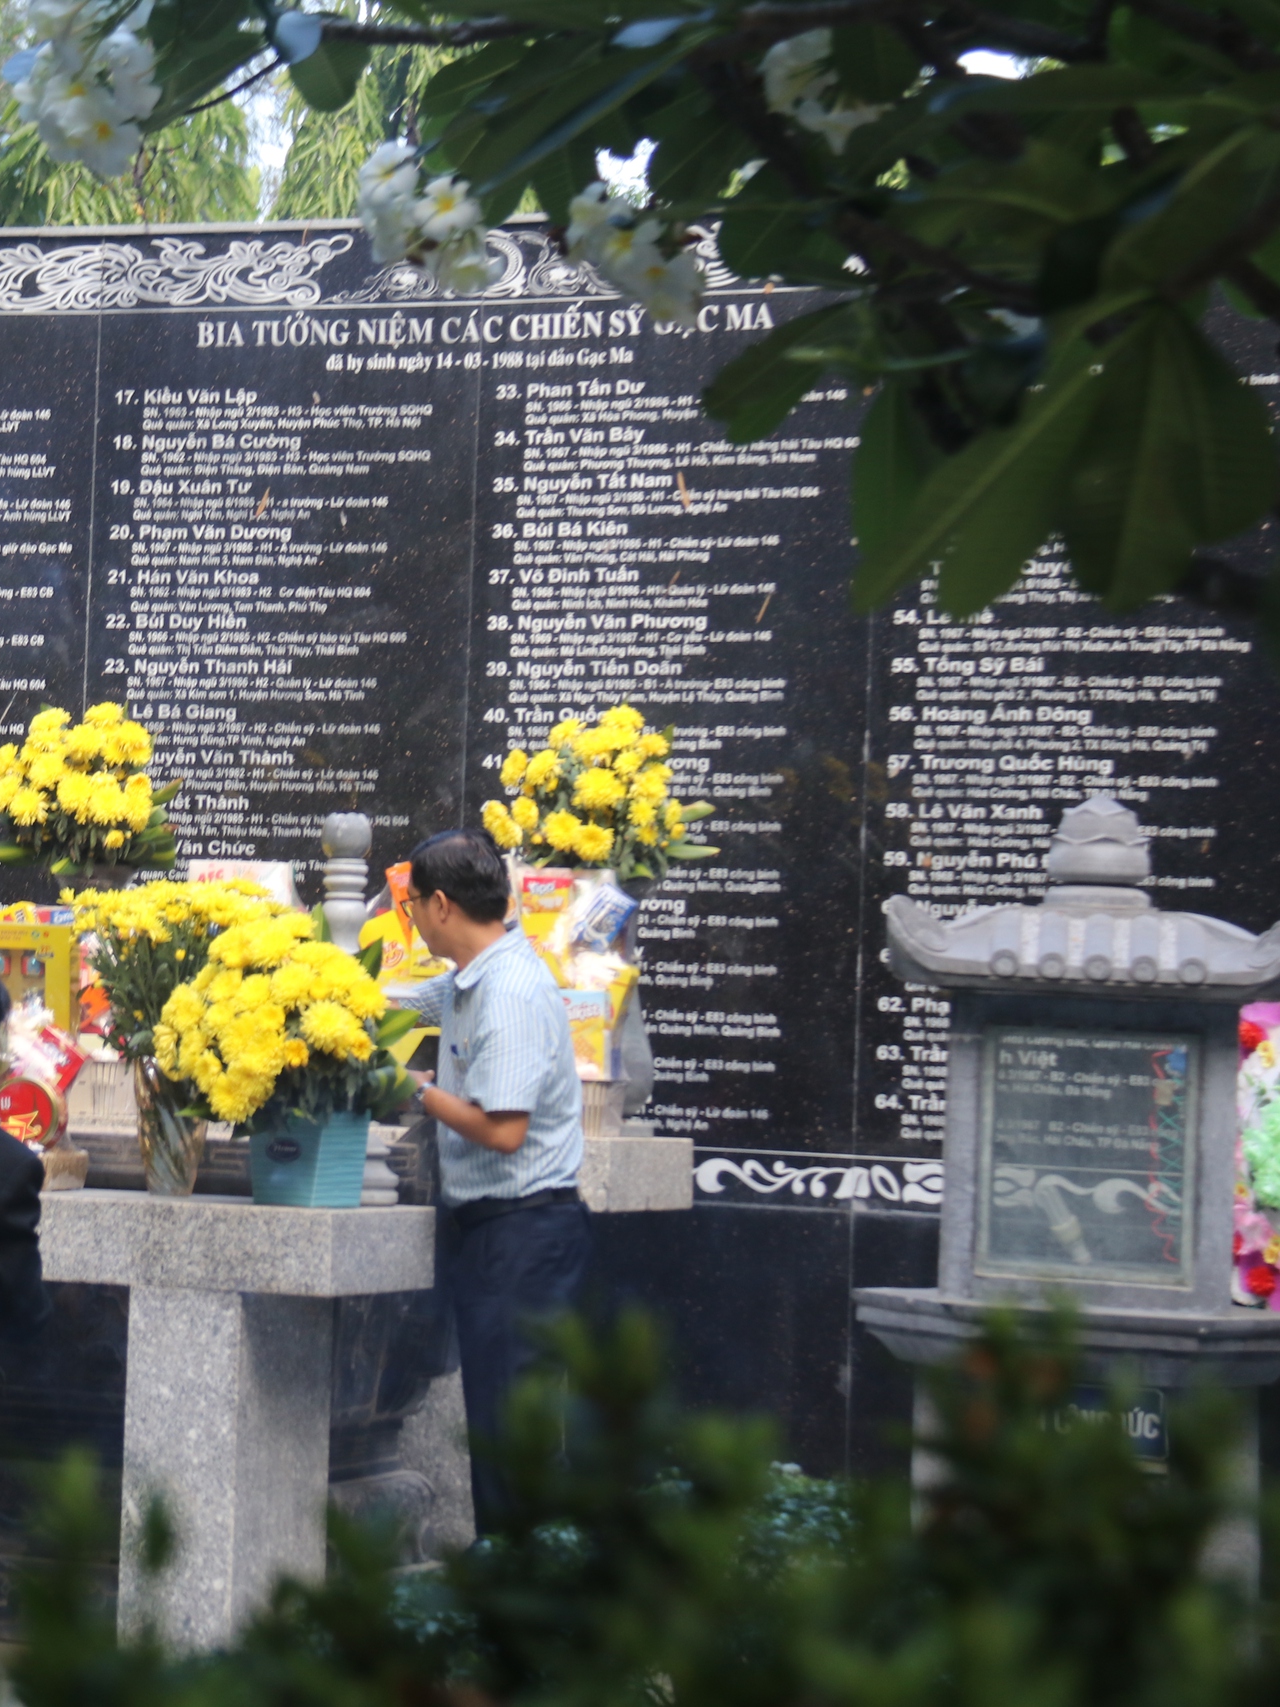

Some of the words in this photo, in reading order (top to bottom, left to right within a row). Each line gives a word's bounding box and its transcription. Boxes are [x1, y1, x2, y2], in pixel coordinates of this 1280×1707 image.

[197, 320, 244, 348] BIA
[252, 310, 351, 347] TƯỞNG
[357, 311, 434, 350] NIỆM
[441, 309, 503, 345] CÁC
[510, 300, 604, 342] CHIẾN
[608, 303, 646, 338] SỸ
[725, 303, 774, 331] MA
[326, 353, 344, 371] đã
[347, 353, 364, 374] hy
[366, 353, 396, 370] sinh
[398, 352, 433, 373] ngày
[492, 351, 524, 369] 1988
[525, 350, 546, 370] tại
[576, 348, 607, 368] Gạc
[609, 346, 634, 365] Ma
[115, 390, 138, 405] 17.
[144, 386, 183, 404] Kiều
[187, 389, 220, 404] Văn
[225, 388, 257, 406] Lập
[496, 384, 522, 400] 33.
[527, 382, 572, 398] Phan
[577, 378, 611, 396] Tấn
[113, 435, 137, 450] 18.
[142, 432, 207, 453] Nguyễn
[212, 434, 235, 450] Bá
[240, 434, 301, 452] Cường
[494, 431, 521, 446] 34.
[524, 426, 565, 445] Trần
[569, 427, 604, 443] Văn
[111, 479, 135, 495] 19.
[139, 479, 173, 498] Đậu
[177, 479, 222, 495] Xuân
[492, 476, 519, 493] 35.
[524, 472, 592, 494] Nguyễn
[597, 470, 627, 489] Tất
[631, 472, 673, 488] Nam
[110, 524, 134, 540] 20.
[139, 524, 188, 543] Phạm
[192, 524, 226, 540] Văn
[230, 524, 292, 543] Dương
[492, 523, 518, 539] 36.
[557, 521, 582, 537] Bá
[586, 520, 628, 536] Kiên
[107, 569, 132, 585] 21.
[137, 569, 172, 585] Hán
[175, 569, 209, 585] Văn
[213, 569, 259, 585] Khoa
[488, 569, 515, 584] 37.
[519, 568, 544, 583] Võ
[594, 564, 639, 583] Tuấn
[106, 613, 131, 629] 22.
[169, 613, 204, 632] Duy
[487, 615, 514, 631] 38.
[518, 612, 587, 634] Nguyễn
[591, 614, 626, 630] Văn
[631, 613, 708, 631] Phương
[104, 658, 129, 674] 23.
[134, 656, 199, 676] Nguyễn
[205, 658, 258, 674] Thanh
[486, 661, 512, 676] 39.
[517, 659, 585, 679] Nguyễn
[589, 657, 630, 676] Tiến
[132, 704, 153, 719] Lê
[158, 704, 181, 719] Bá
[186, 704, 237, 722] Giang
[200, 749, 234, 765] Văn
[885, 803, 913, 819] 58.
[918, 802, 943, 819] Lê
[947, 803, 986, 819] Văn
[989, 804, 1043, 820] Xanh
